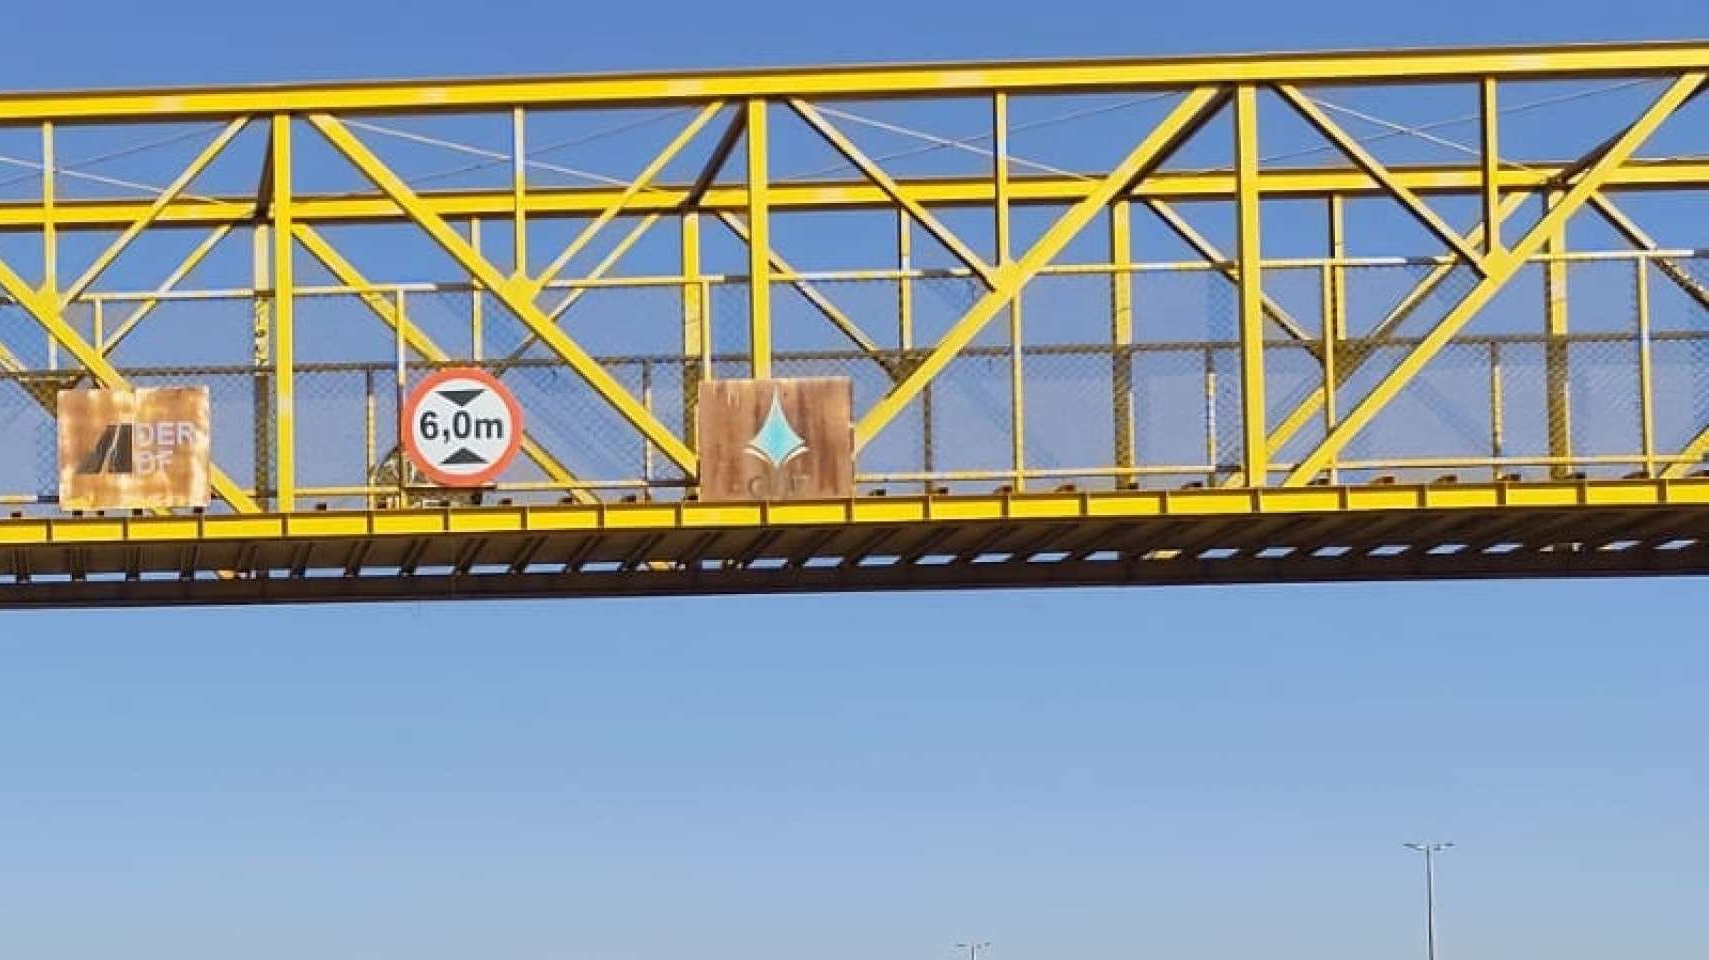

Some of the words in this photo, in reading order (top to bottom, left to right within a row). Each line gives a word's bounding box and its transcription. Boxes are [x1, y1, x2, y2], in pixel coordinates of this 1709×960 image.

[135, 422, 197, 446] DER
[420, 409, 504, 444] 6,0m
[136, 451, 174, 475] DF
